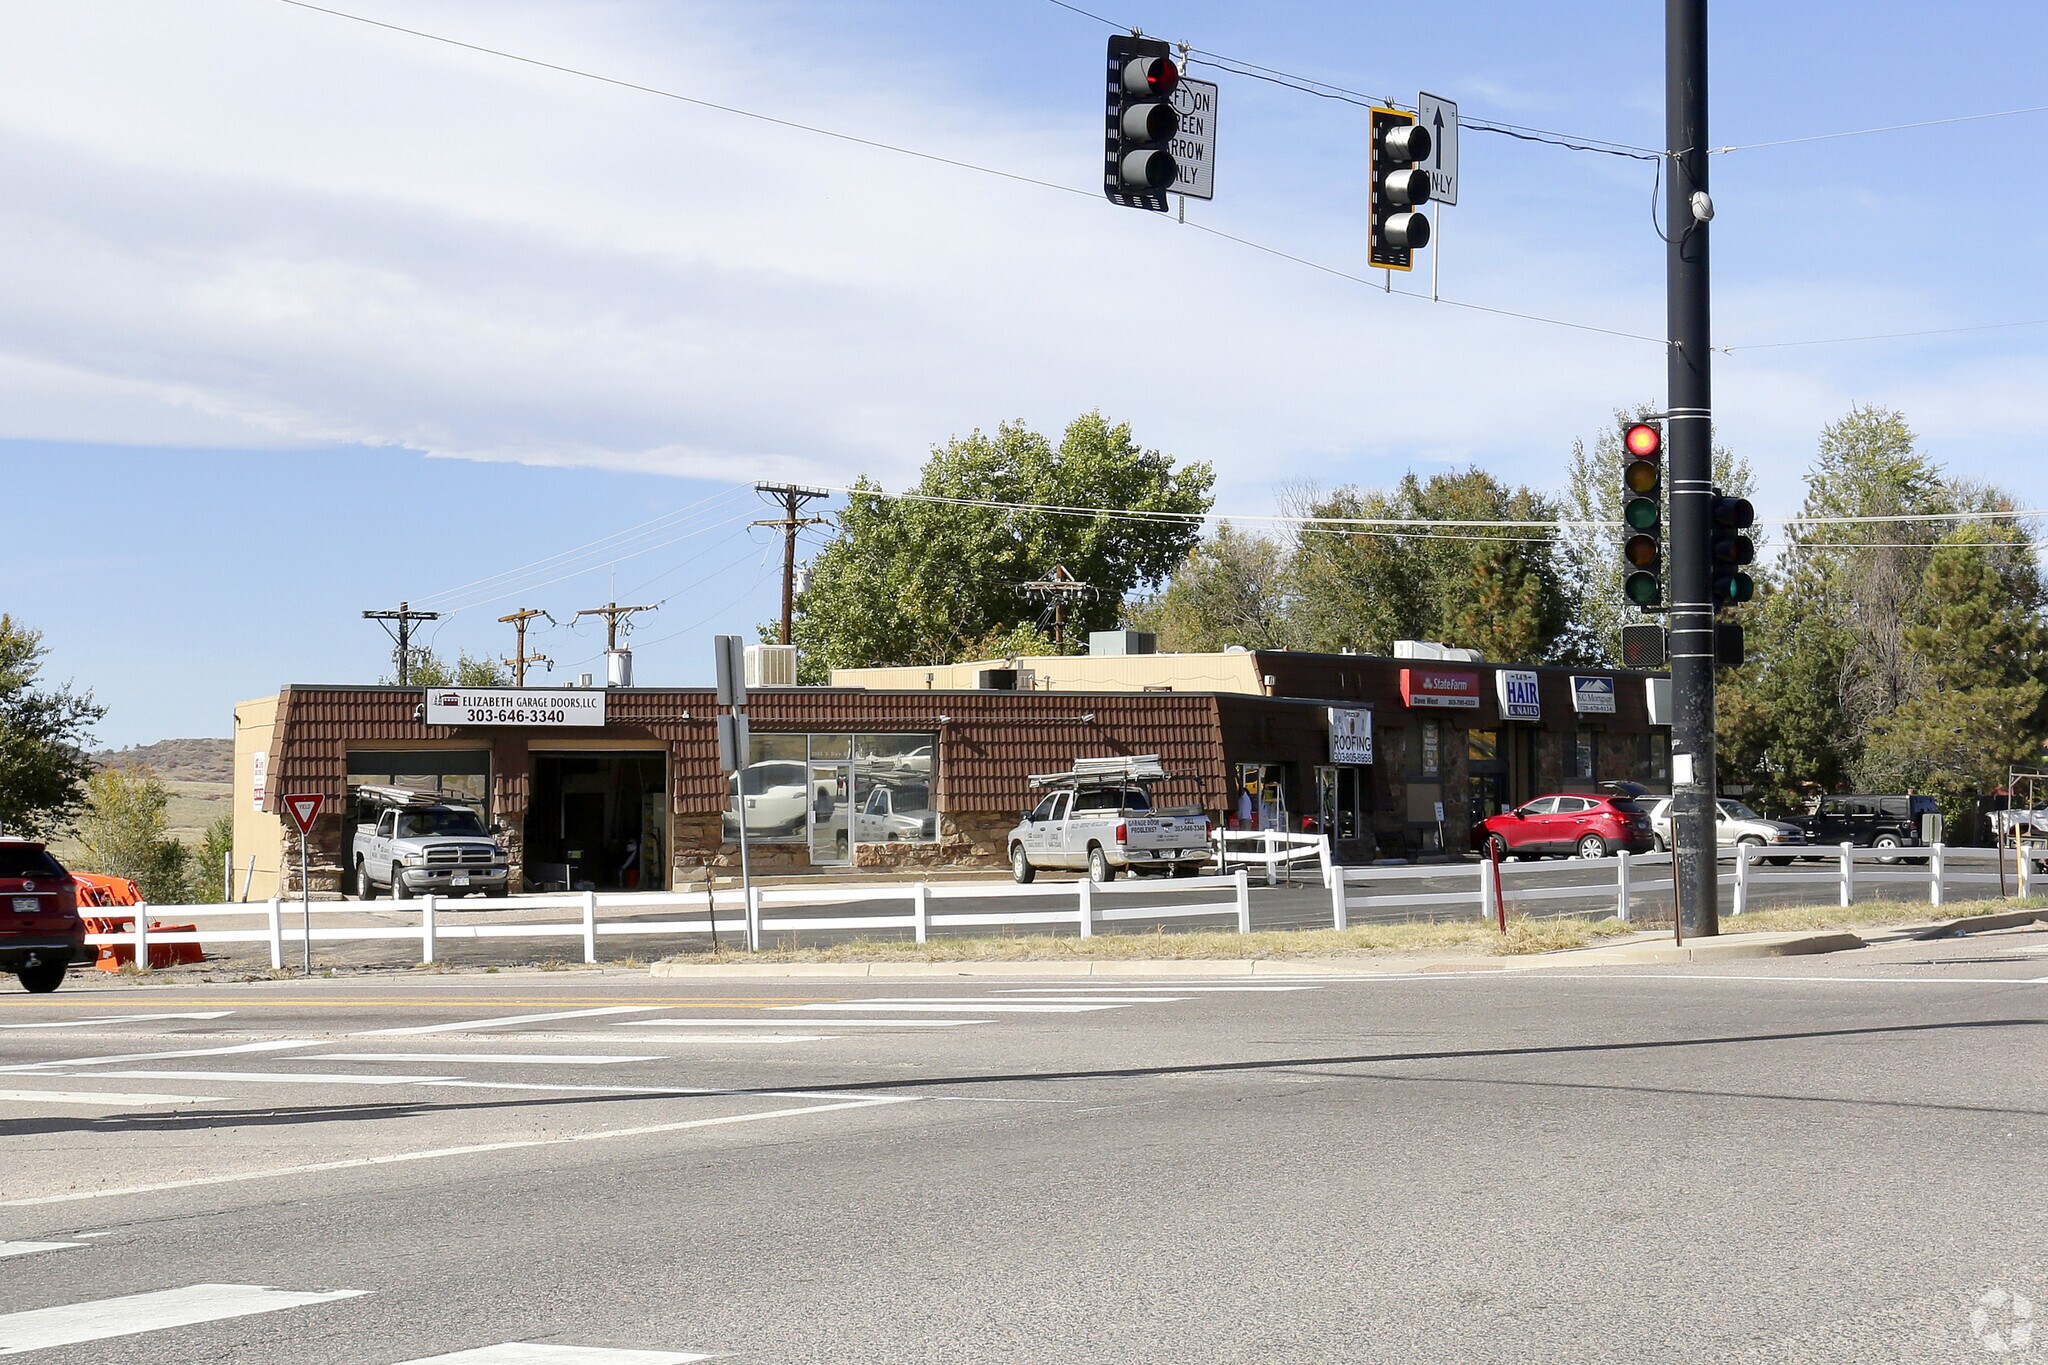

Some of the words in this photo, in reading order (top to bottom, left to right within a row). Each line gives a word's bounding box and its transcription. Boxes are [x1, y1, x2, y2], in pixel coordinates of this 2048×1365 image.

[1195, 92, 1210, 112] ON
[1177, 114, 1204, 136] REEN
[1176, 163, 1198, 184] NLY
[1430, 171, 1453, 195] NLY
[463, 696, 513, 707] ELIZABETH
[516, 696, 548, 708] GARAGE
[1507, 681, 1539, 704] HAIR
[467, 709, 565, 723] 303-646-3340
[1510, 706, 1517, 715] &
[1517, 706, 1538, 716] NAILS
[1333, 735, 1371, 751] ROOFING
